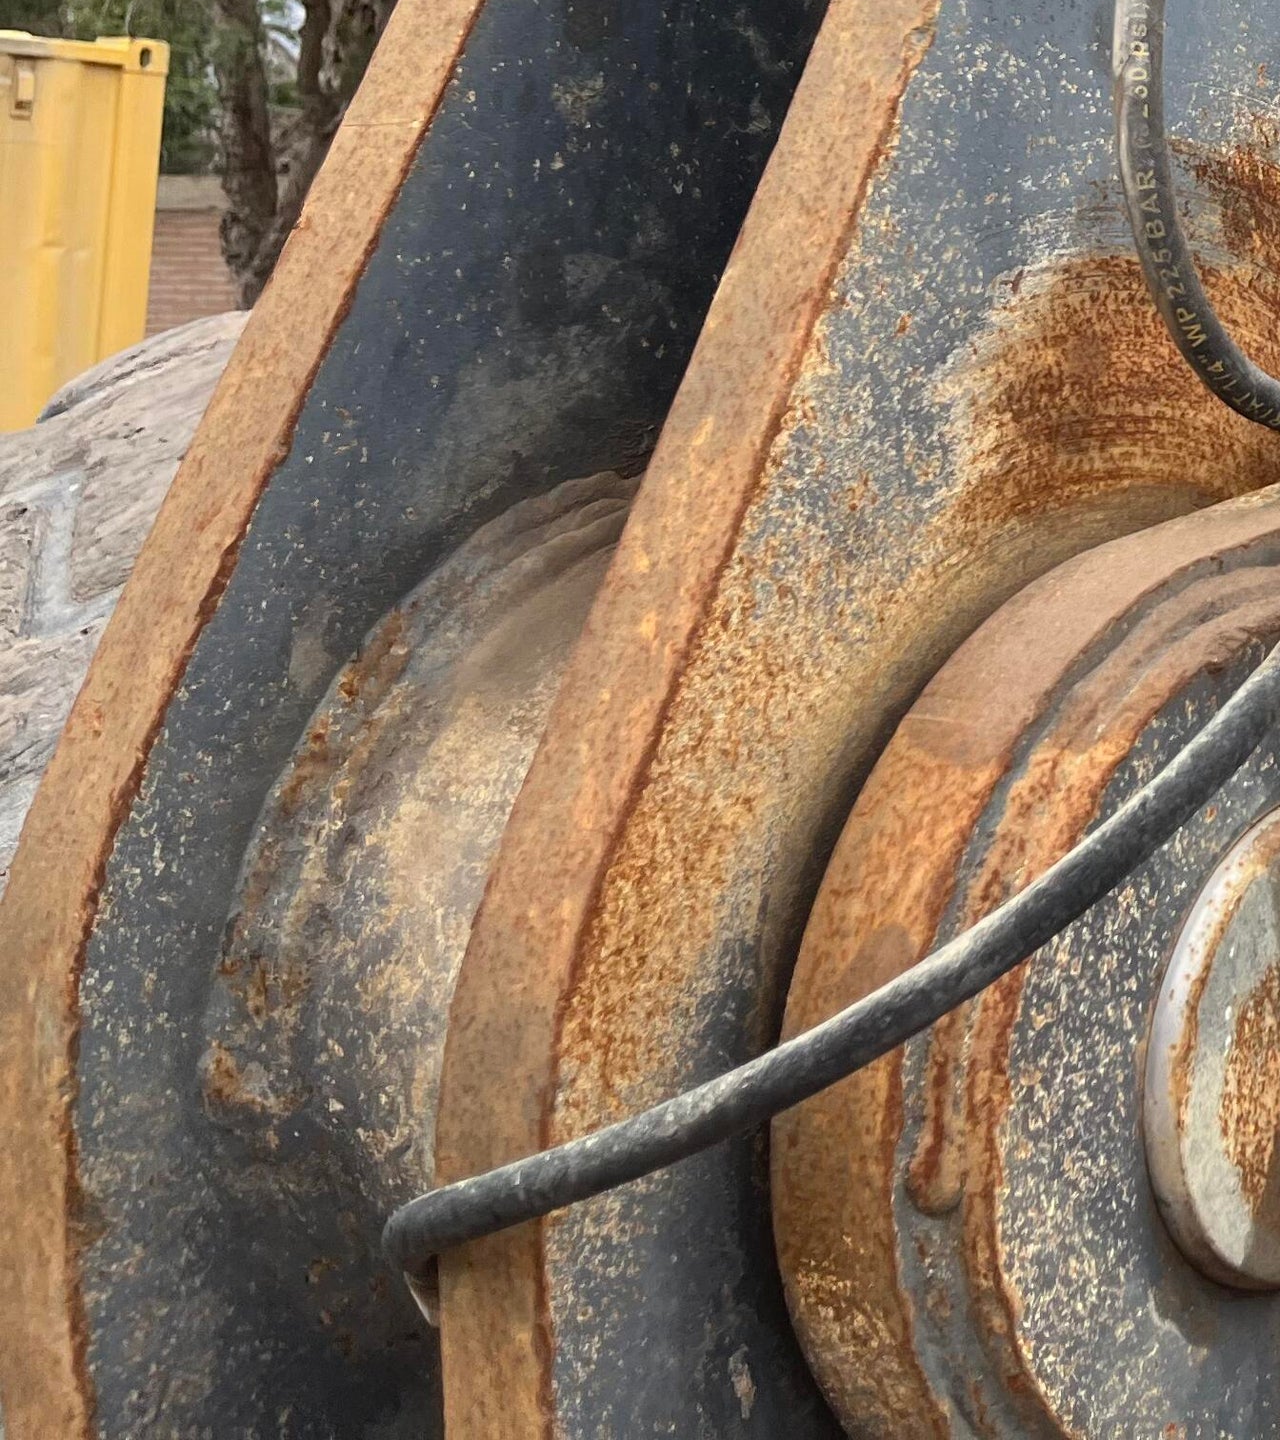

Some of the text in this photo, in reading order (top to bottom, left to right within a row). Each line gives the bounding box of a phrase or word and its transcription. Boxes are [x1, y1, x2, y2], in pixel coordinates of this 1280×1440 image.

[1135, 169, 1167, 240] BAR
[1152, 248, 1186, 299] 225
[1175, 307, 1208, 348] WP
